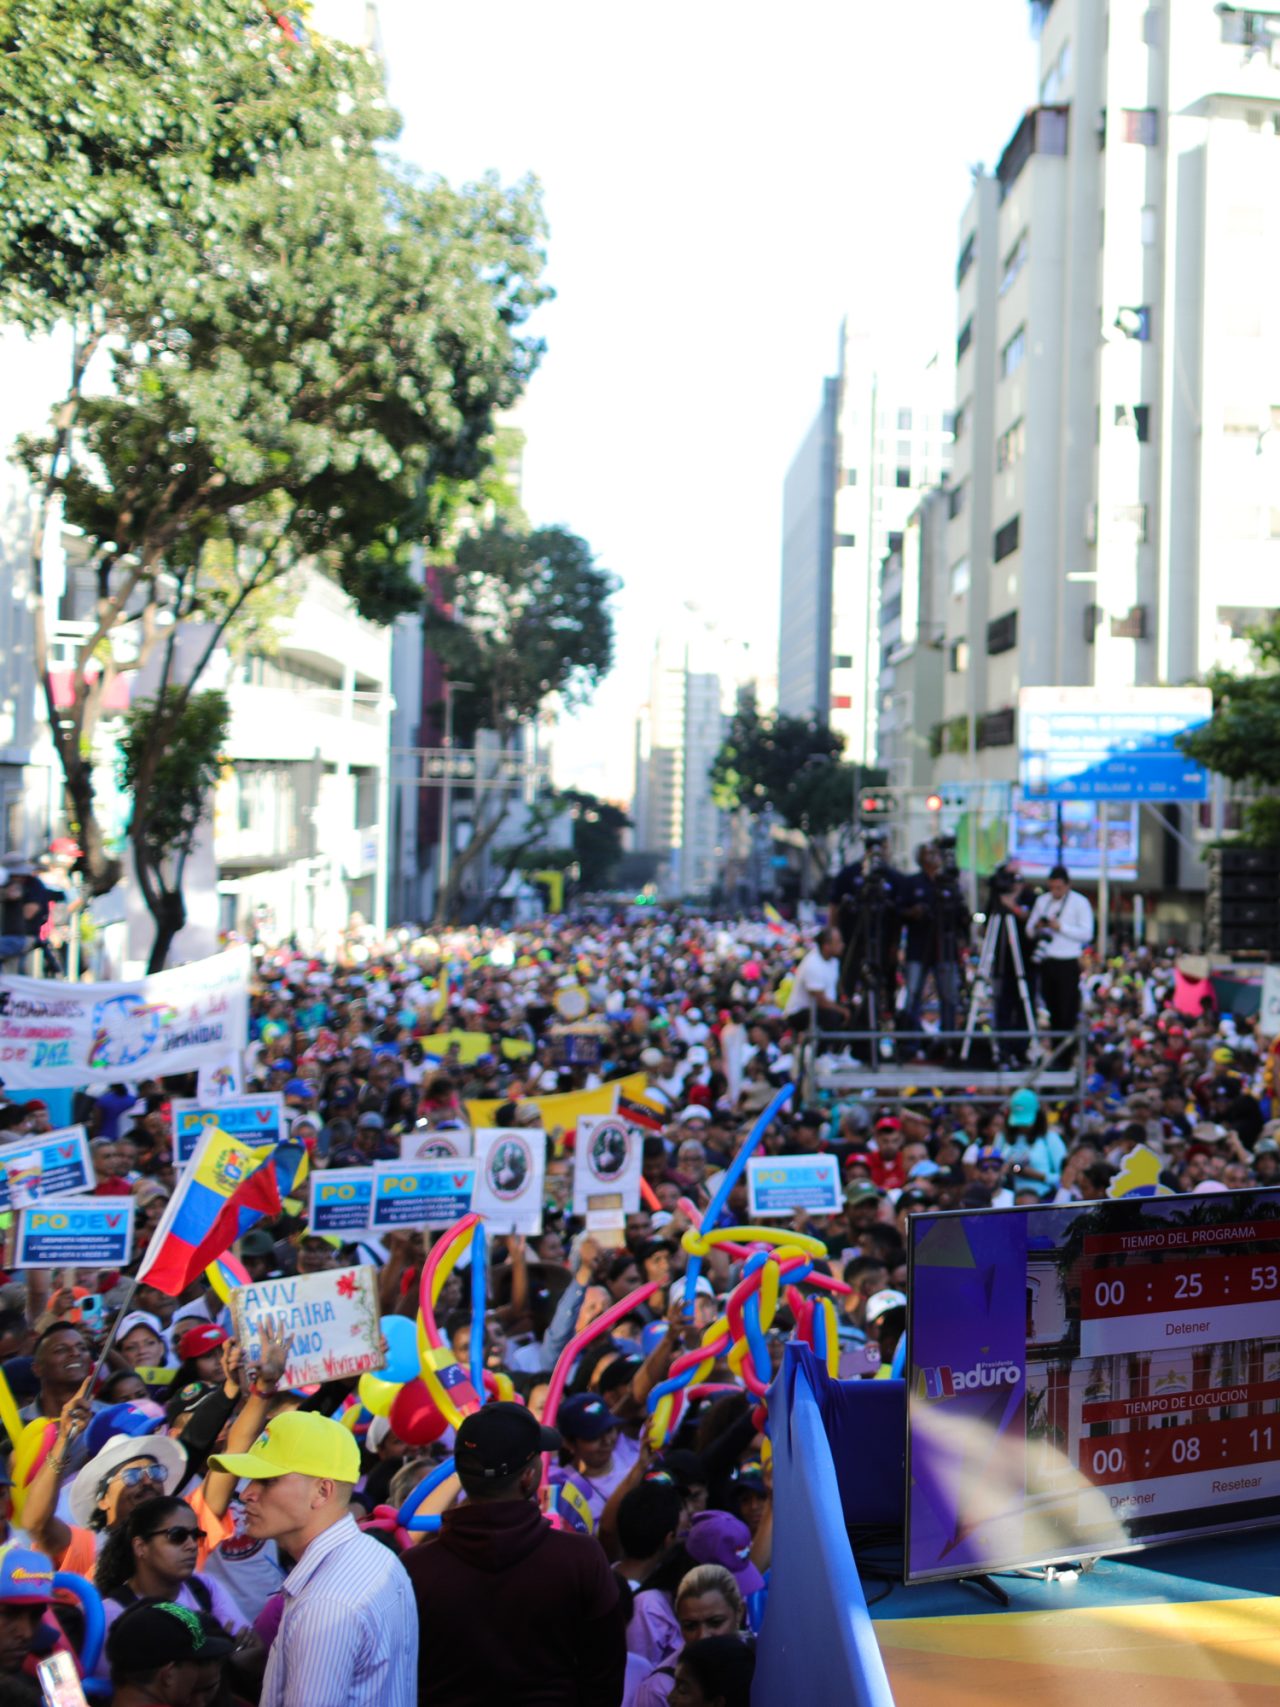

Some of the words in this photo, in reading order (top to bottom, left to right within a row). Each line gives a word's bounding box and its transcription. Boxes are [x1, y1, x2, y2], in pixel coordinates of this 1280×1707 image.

[31, 1213, 123, 1230] PODEV
[1120, 1233, 1165, 1249] TIEMPO
[1168, 1231, 1190, 1245] DEL
[1192, 1226, 1256, 1243] PROGRAMA
[1095, 1280, 1125, 1307] 00
[1174, 1273, 1203, 1299] 25
[1250, 1265, 1278, 1291] 53
[1165, 1320, 1211, 1337] Detener
[1125, 1399, 1168, 1415] TIEMPO
[1171, 1396, 1186, 1409] DE
[1189, 1389, 1249, 1408] LOCUCION
[1093, 1447, 1123, 1475] 00
[1172, 1437, 1200, 1463] 08
[1249, 1426, 1273, 1452] 11
[1110, 1491, 1156, 1508] Detener
[1212, 1475, 1262, 1494] Resetear
